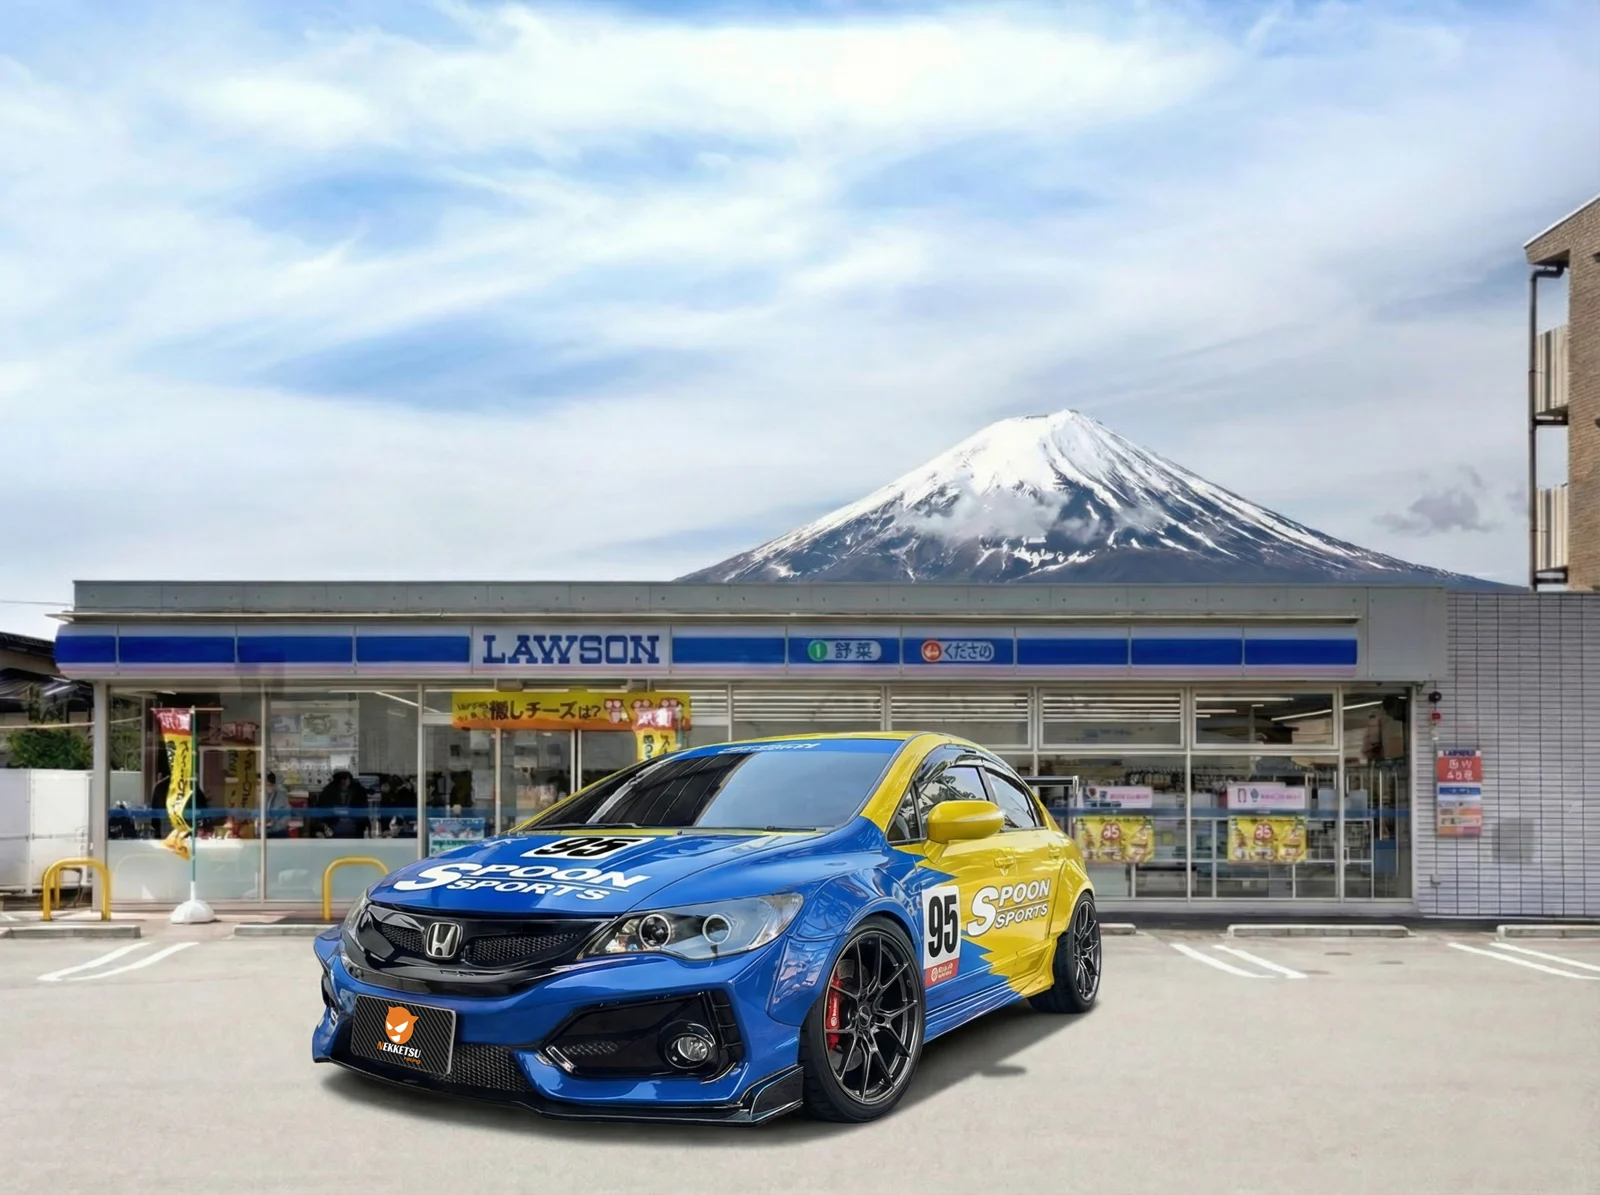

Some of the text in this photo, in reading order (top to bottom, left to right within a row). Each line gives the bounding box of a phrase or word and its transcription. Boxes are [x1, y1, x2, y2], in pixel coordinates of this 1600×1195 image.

[482, 634, 660, 664] LAWSON
[533, 837, 642, 857] 95
[393, 862, 653, 891] SPOON
[446, 879, 611, 901] SPORTS
[967, 878, 1051, 938] SPOON
[994, 903, 1049, 930] SPORTS
[928, 894, 959, 959] 95
[376, 1040, 422, 1059] NEKKETSU
